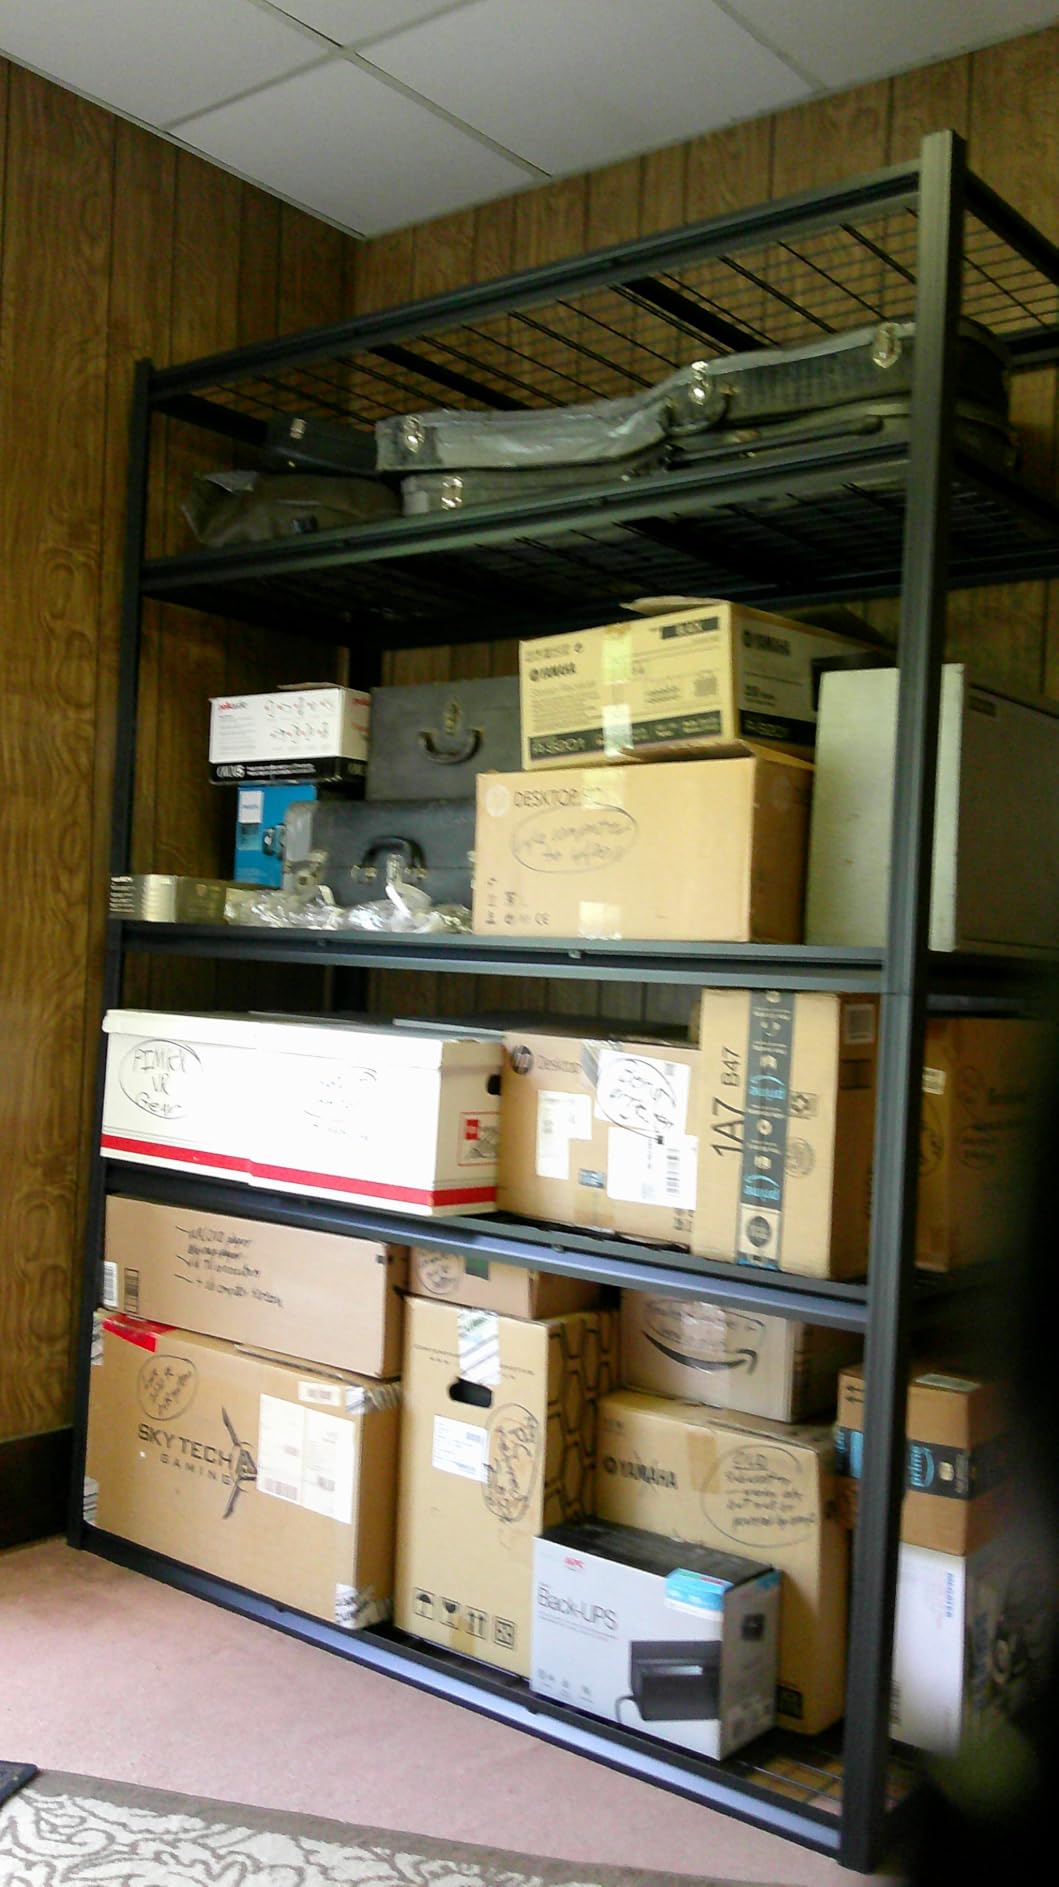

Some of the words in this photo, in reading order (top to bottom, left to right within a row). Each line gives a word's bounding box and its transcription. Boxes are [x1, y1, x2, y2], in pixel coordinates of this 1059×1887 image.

[720, 1047, 743, 1088] B47
[160, 1453, 234, 1486] GAMING
[618, 1462, 679, 1490] YAMAHA
